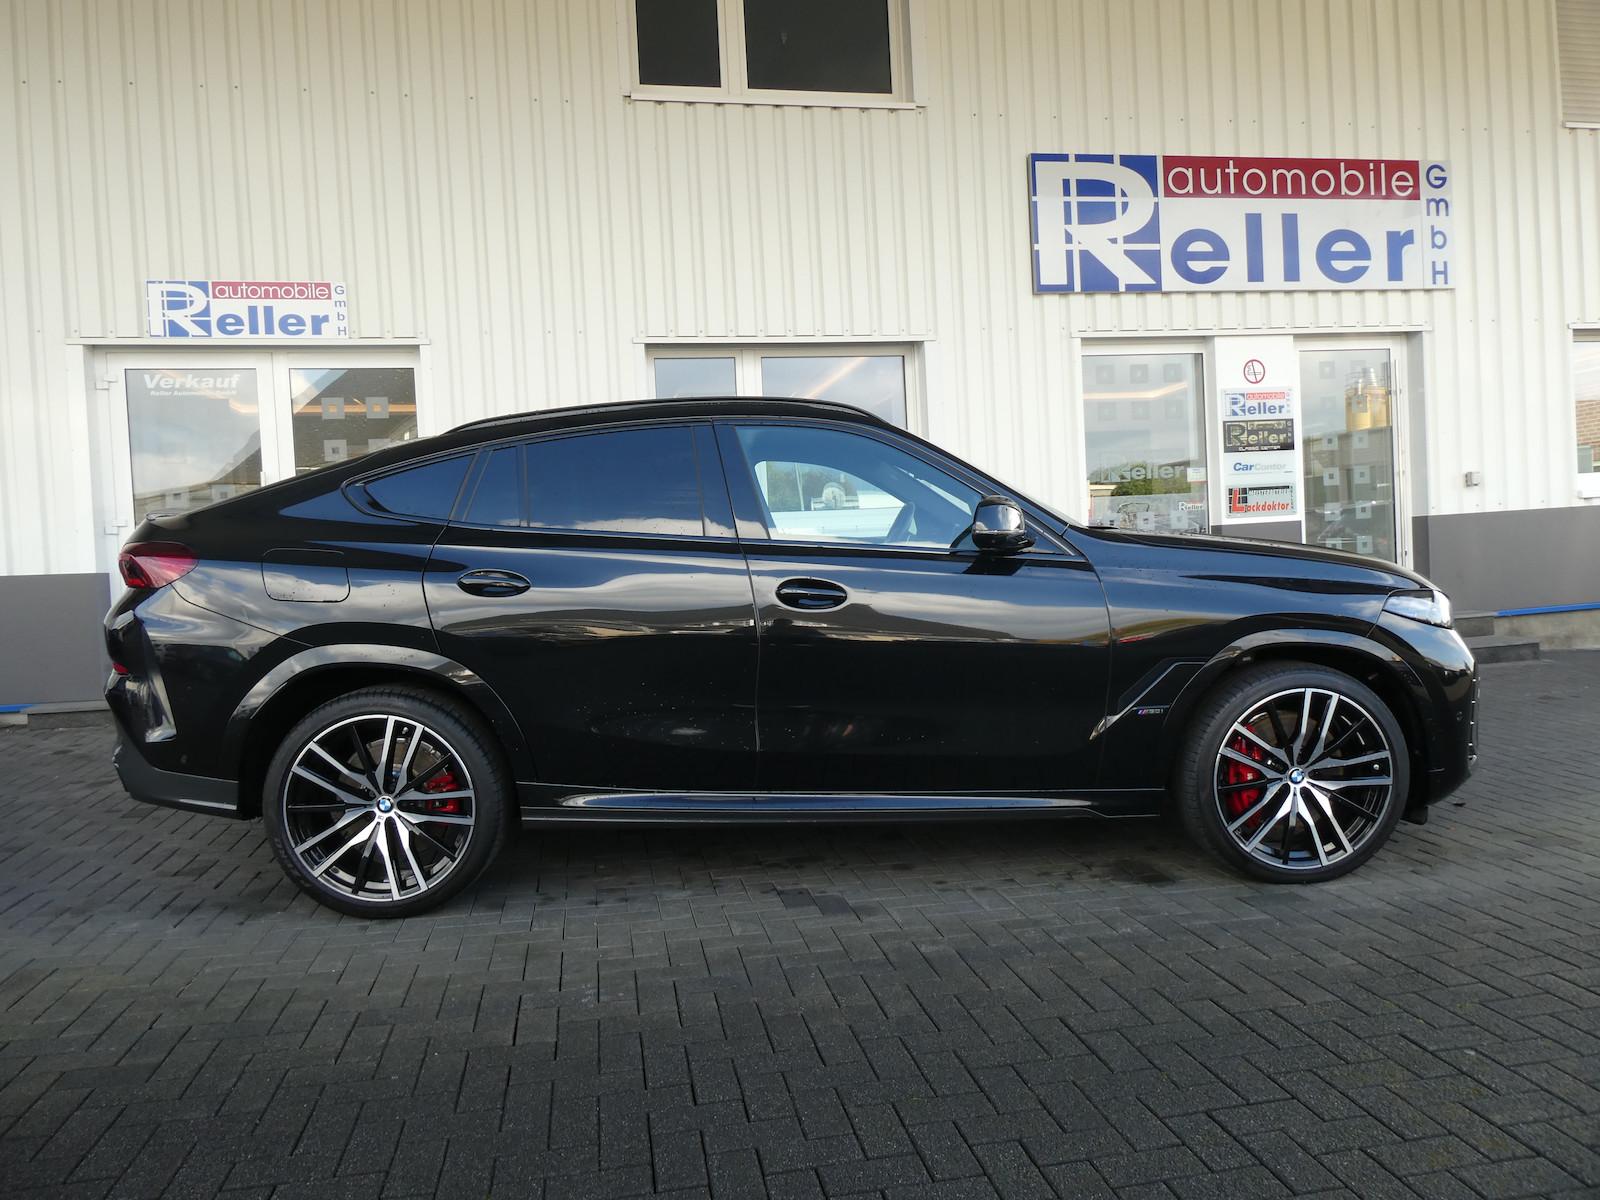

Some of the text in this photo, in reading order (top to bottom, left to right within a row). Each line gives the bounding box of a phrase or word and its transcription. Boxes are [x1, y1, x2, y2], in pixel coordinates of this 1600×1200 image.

[1167, 160, 1414, 196] automobile
[1034, 161, 1415, 286] Reller
[1425, 163, 1449, 286] GmbH
[214, 284, 329, 299] automobile
[148, 283, 330, 337] Reller
[334, 285, 348, 336] GmbH
[143, 374, 240, 389] Verkauf
[1225, 393, 1285, 416] Reller
[1226, 423, 1287, 446] Reller
